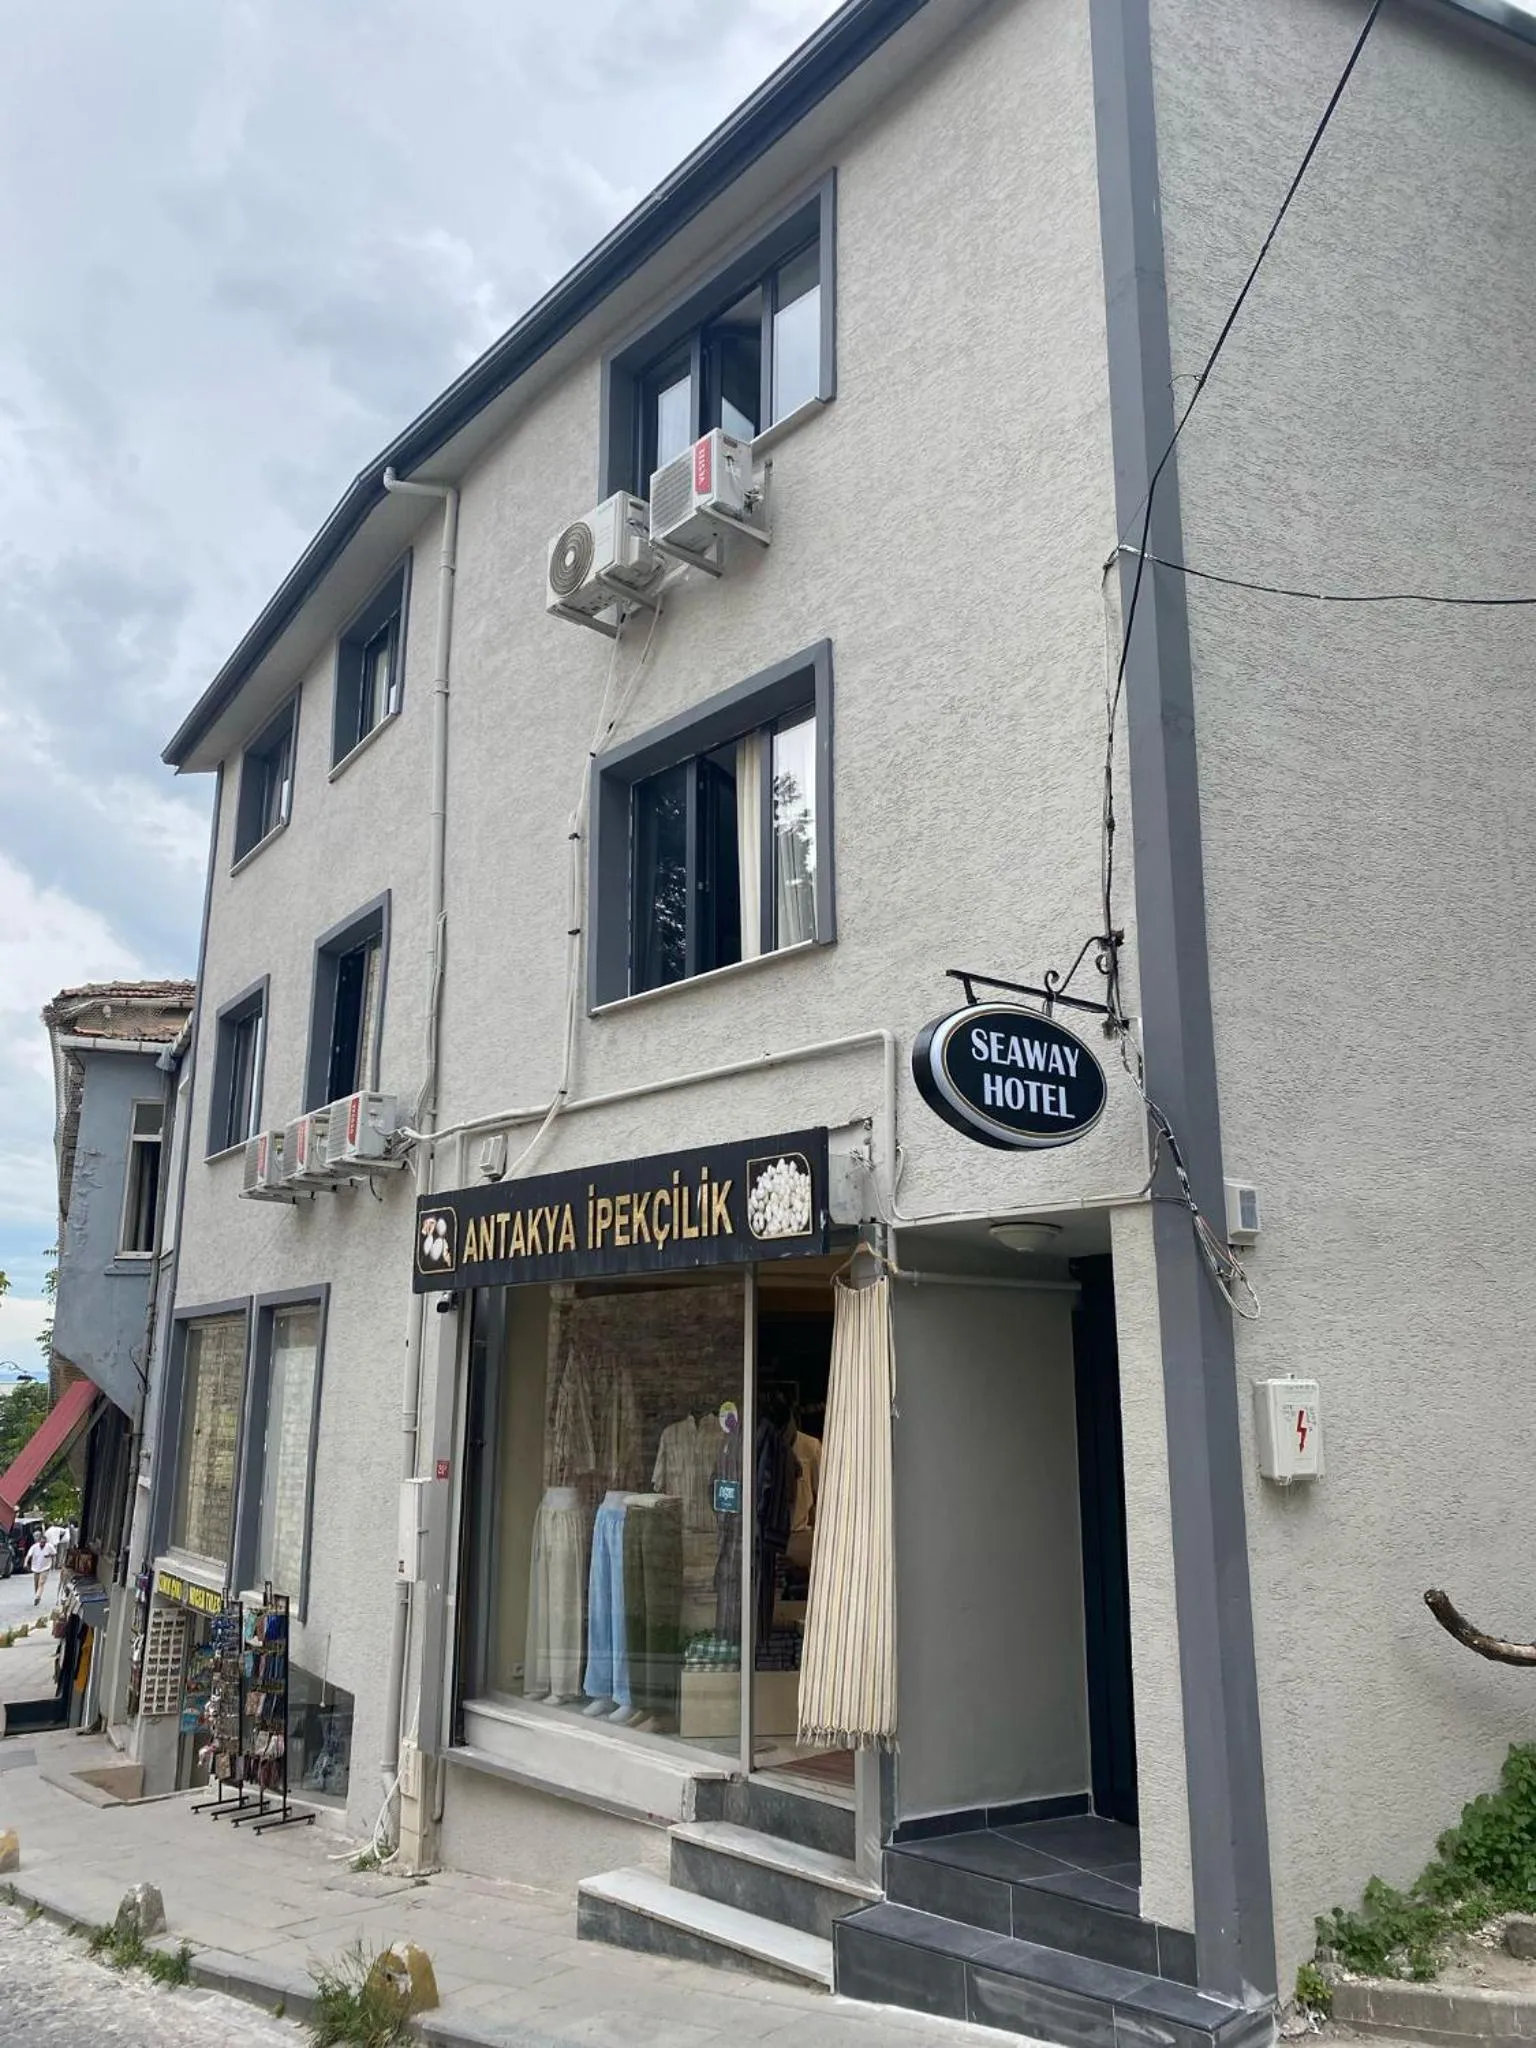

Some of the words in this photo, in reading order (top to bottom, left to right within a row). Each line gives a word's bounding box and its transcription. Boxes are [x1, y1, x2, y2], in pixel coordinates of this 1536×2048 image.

[971, 1028, 1080, 1078] SEAWAY
[983, 1073, 1076, 1119] HOTEL
[463, 1203, 576, 1264] ANTAKYA
[588, 1166, 734, 1251] İPEKÇİLİK
